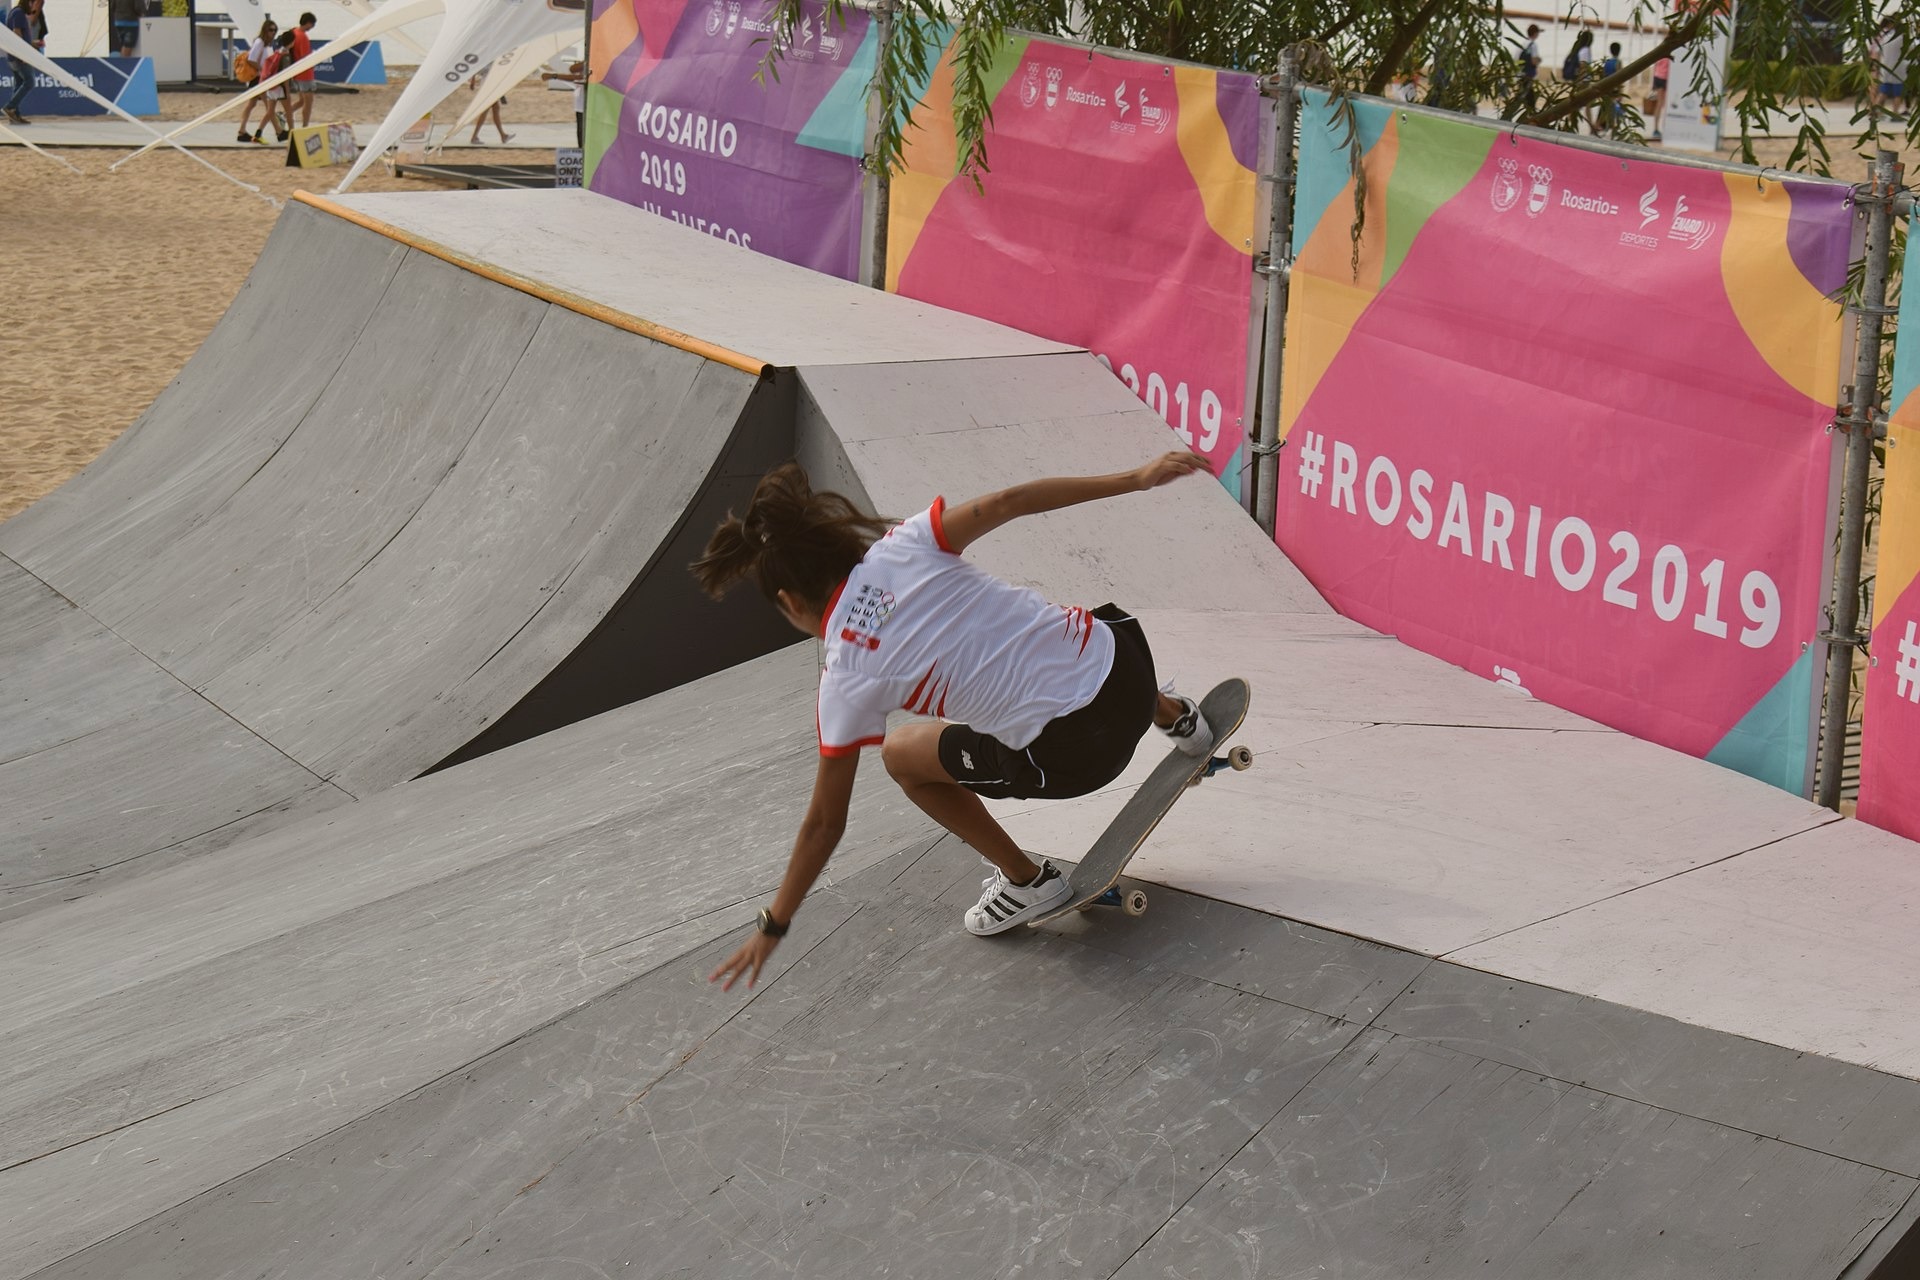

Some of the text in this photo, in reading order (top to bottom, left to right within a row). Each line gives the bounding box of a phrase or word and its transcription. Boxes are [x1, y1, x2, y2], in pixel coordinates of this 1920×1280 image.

[638, 102, 737, 157] ROSARIO
[640, 151, 686, 196] 2019
[1620, 232, 1659, 247] DEPORTES
[1299, 430, 1782, 648] #ROSARIO2019
[847, 584, 872, 624] TEAM
